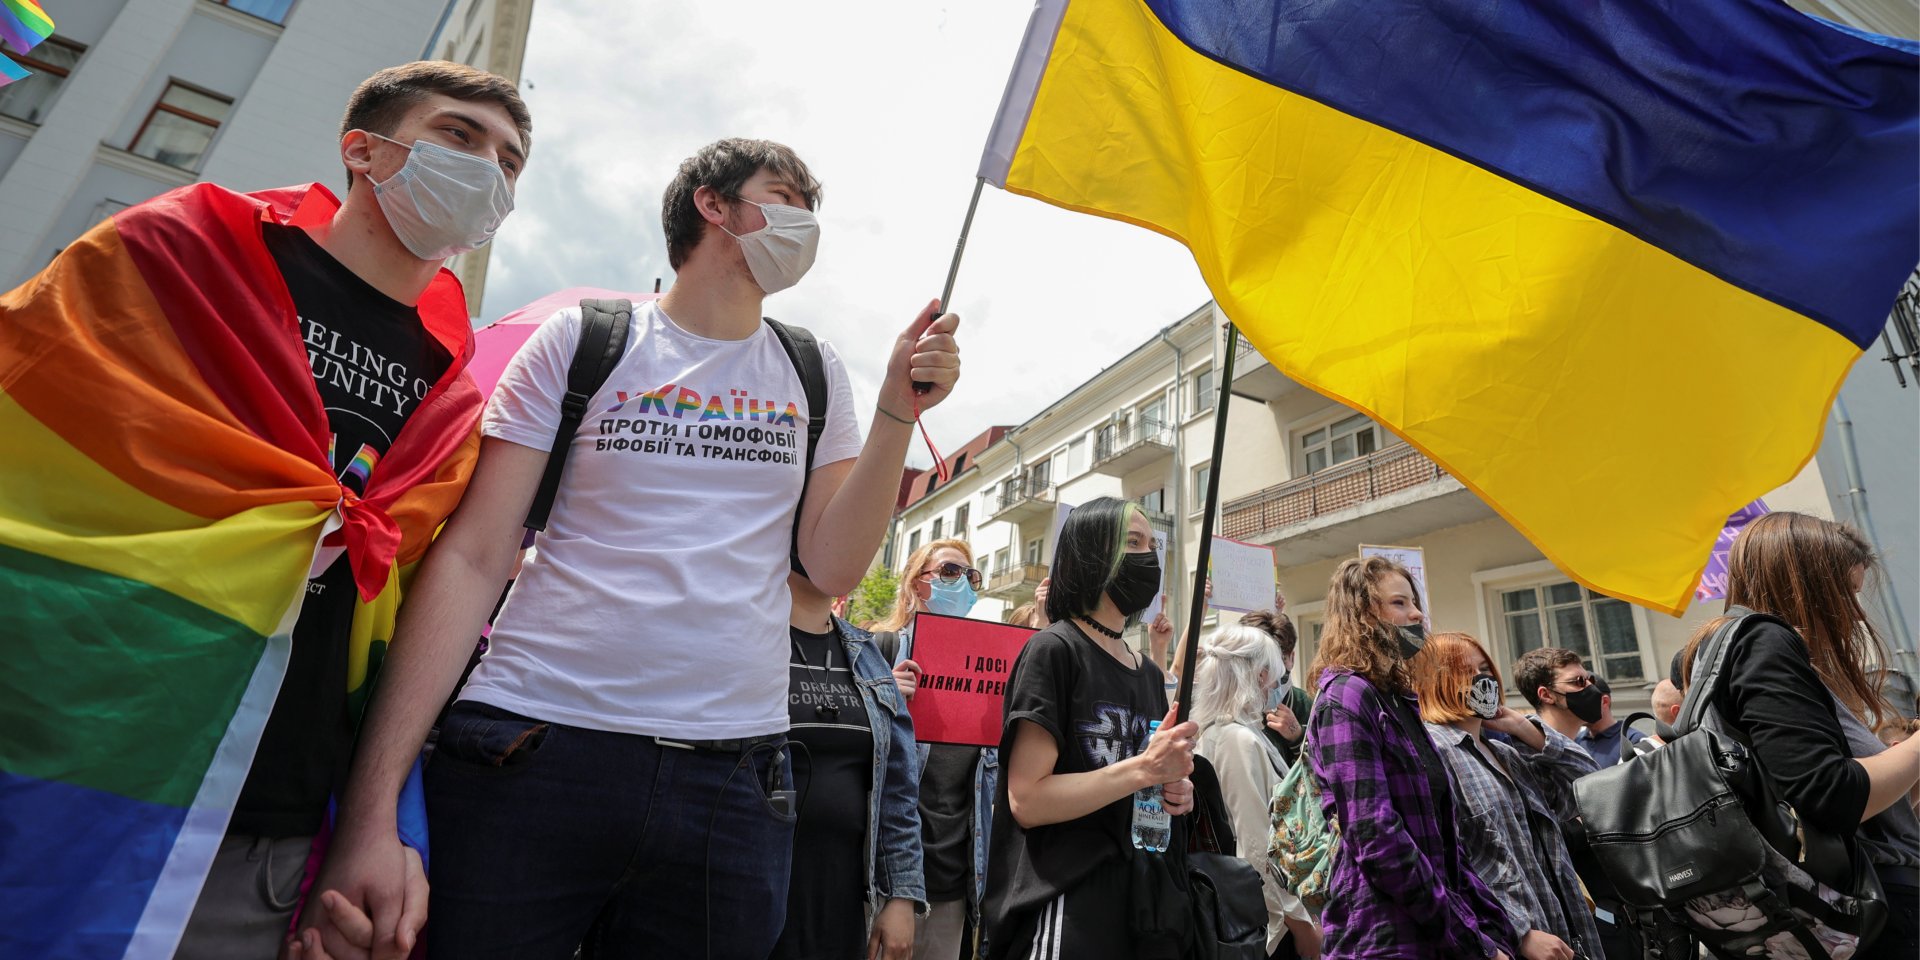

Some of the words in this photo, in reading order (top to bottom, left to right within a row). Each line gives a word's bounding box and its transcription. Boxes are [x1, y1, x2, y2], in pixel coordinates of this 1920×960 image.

[297, 315, 407, 388] ELING
[413, 377, 433, 401] O
[606, 383, 799, 428] УКРАЇНА
[599, 418, 678, 438] ПРОТИ
[684, 424, 797, 449] ГОМОФОБІЇ
[595, 437, 672, 455] БІФОБІЇ
[674, 442, 696, 457] ТА
[701, 444, 798, 466] ТРАНСФОБІЇ
[965, 655, 970, 670] І
[974, 656, 1007, 674] ДОСІ
[800, 681, 854, 695] DREAM
[918, 673, 973, 693] НІЯКИХ
[789, 693, 836, 708] COME
[840, 695, 861, 708] TR
[1138, 802, 1165, 816] AQUA
[1668, 868, 1694, 883] HARVEST
